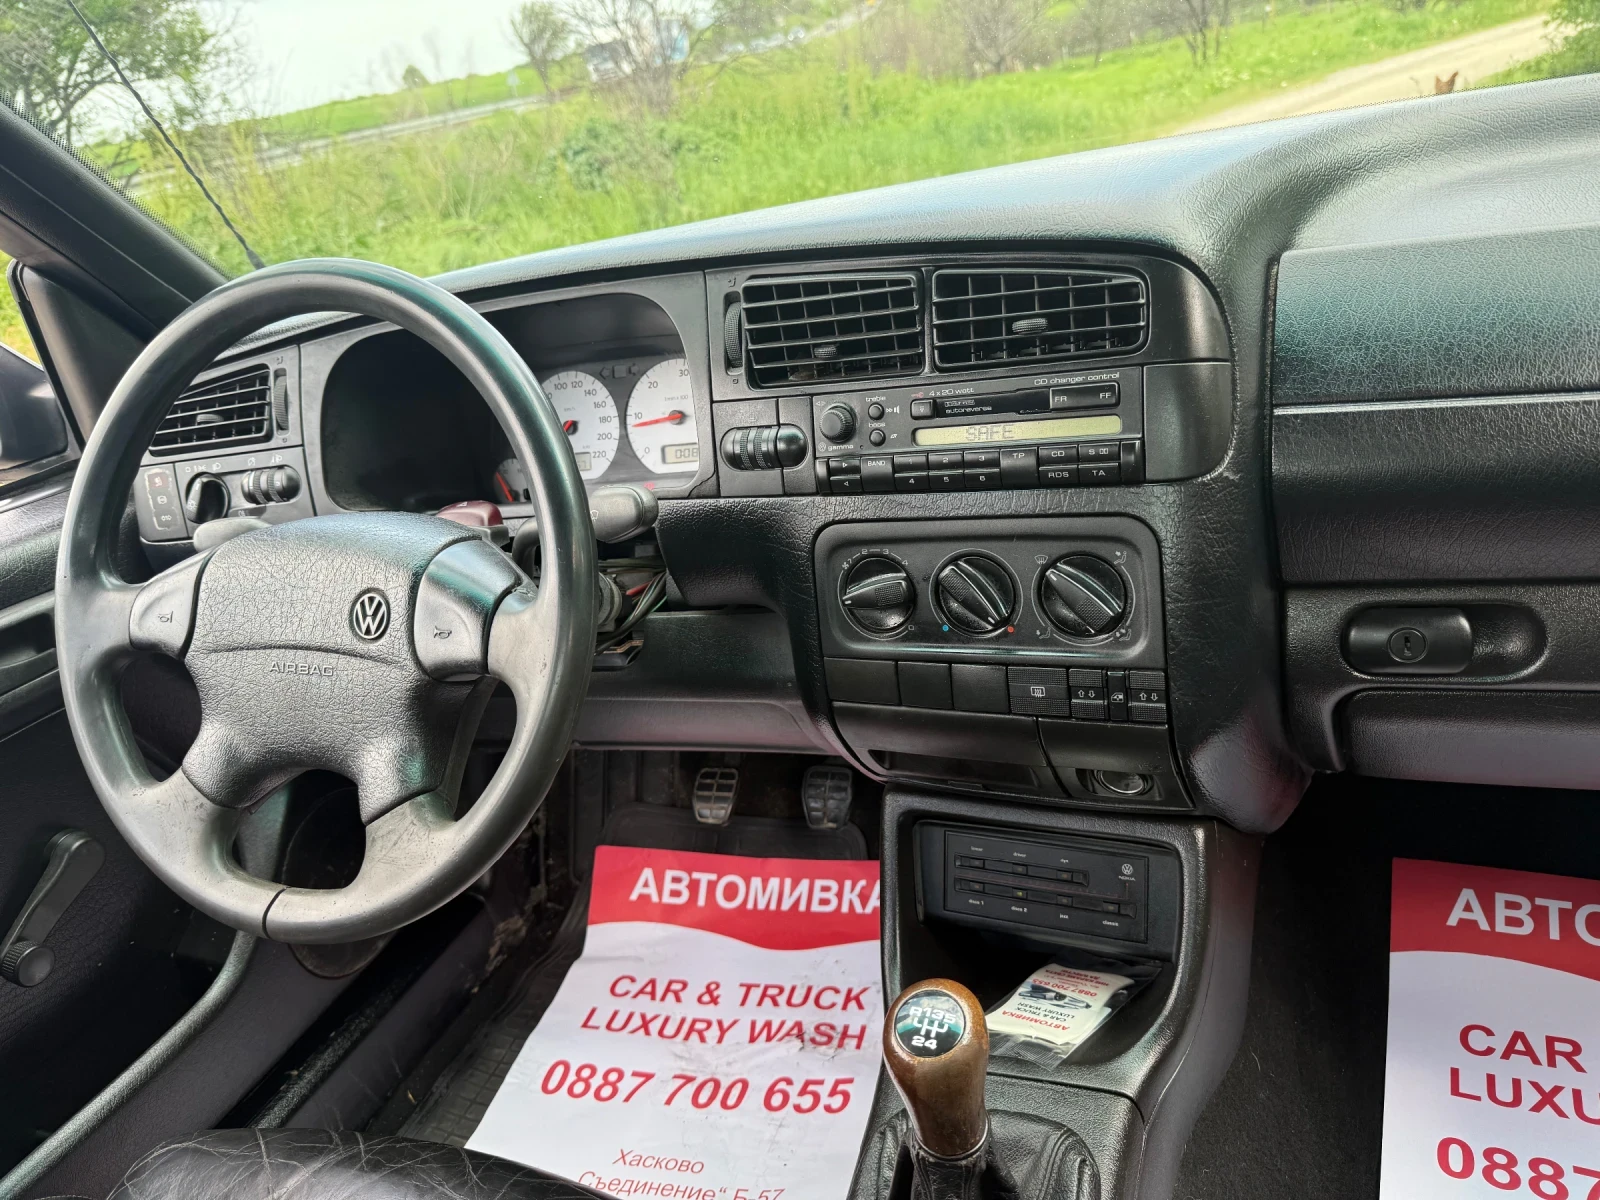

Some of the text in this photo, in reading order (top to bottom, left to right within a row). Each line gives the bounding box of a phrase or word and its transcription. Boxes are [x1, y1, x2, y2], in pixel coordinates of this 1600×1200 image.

[1034, 372, 1119, 386] CD changer control
[554, 382, 568, 390] 100
[571, 380, 583, 388] 120
[648, 380, 658, 388] 20
[584, 388, 597, 397] 140
[1100, 392, 1111, 400] FF
[1054, 395, 1067, 403] FR
[594, 400, 606, 408] 160
[946, 406, 992, 414] autoreverse
[634, 412, 642, 420] 10
[598, 432, 612, 440] 200
[965, 426, 1014, 441] SAFE
[1048, 470, 1069, 479] RDS
[1092, 469, 1106, 477] TA
[979, 474, 986, 482] 6
[269, 662, 334, 676] AIRBAG
[1032, 978, 1050, 987] 655
[1052, 983, 1070, 991] 700
[608, 975, 870, 1011] CAR & TRUCK
[1072, 988, 1097, 997] 0887
[1014, 1006, 1041, 1016] TRUCK
[1017, 1002, 1075, 1019] LUXURY WASH
[1002, 1010, 1070, 1031] АВТОМИВКА
[1050, 1013, 1067, 1022] CAR
[580, 1006, 868, 1050] LUXURY WASH
[1459, 1024, 1588, 1074] CAR
[540, 1060, 854, 1114] 0887 700 655
[1449, 1066, 1600, 1126] LUXU
[612, 1148, 705, 1174] Хасково
